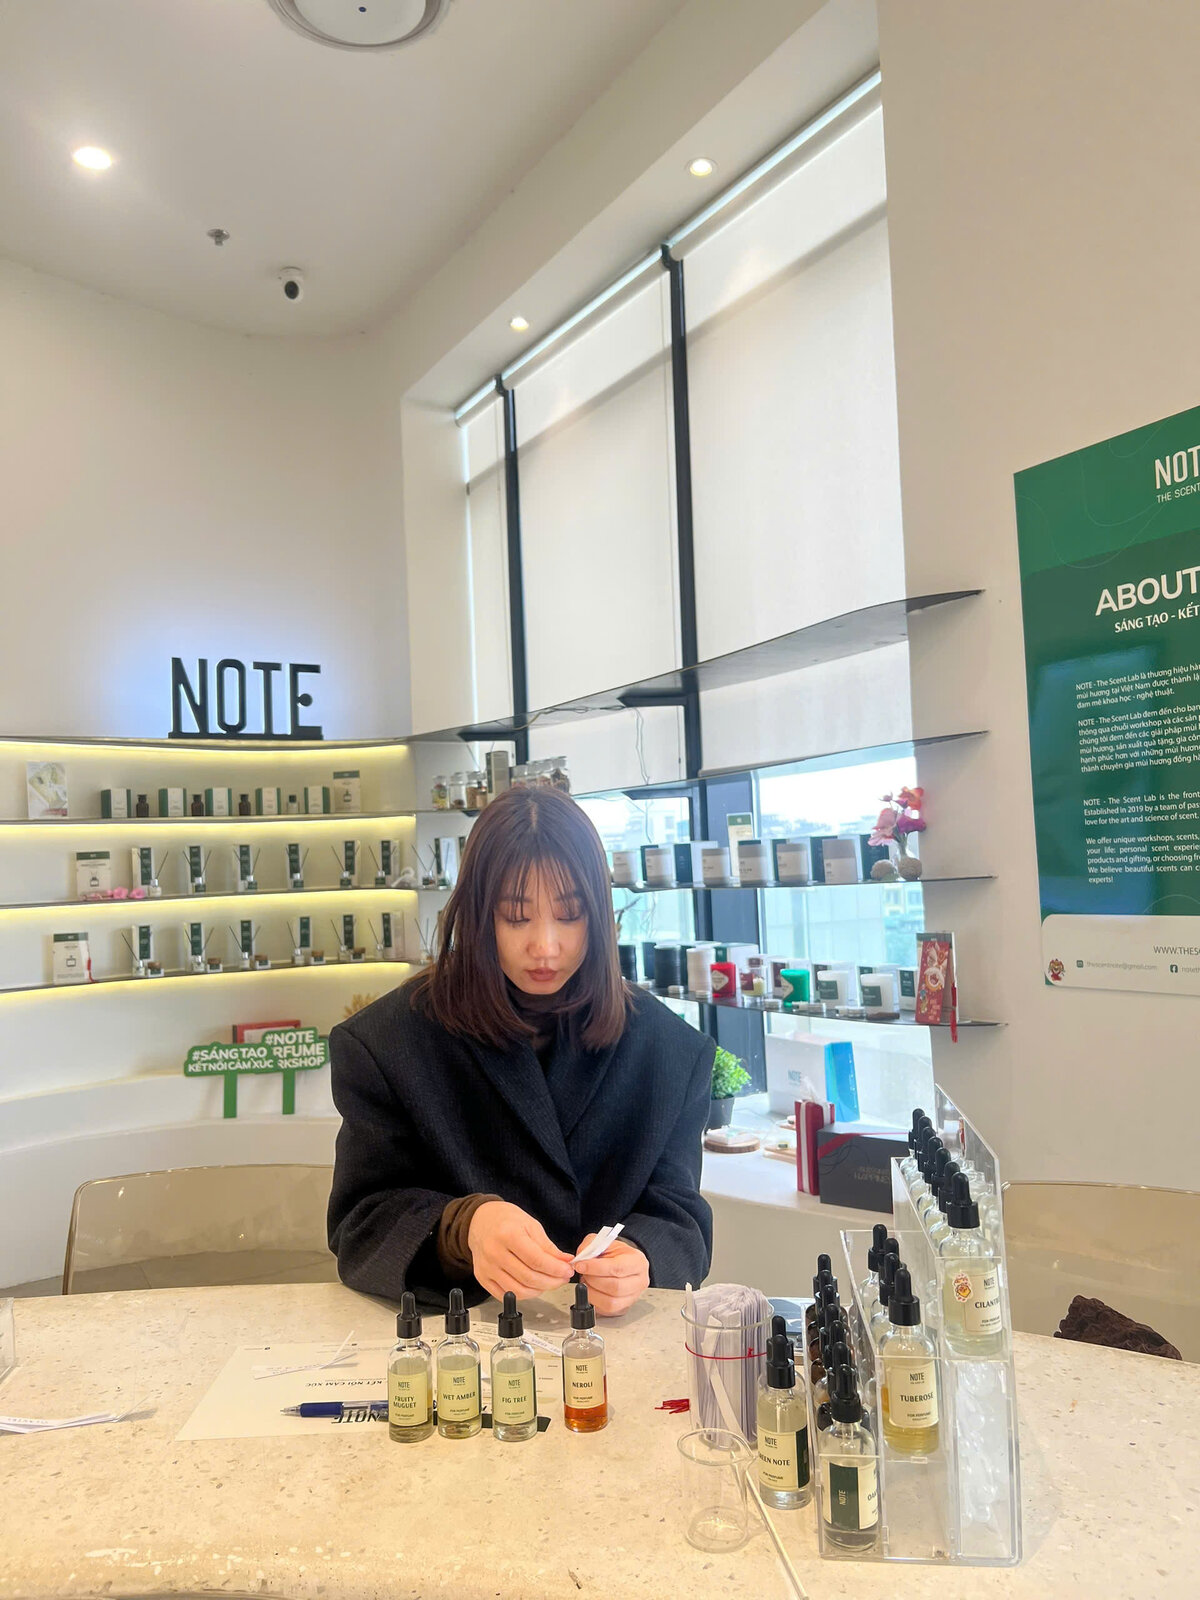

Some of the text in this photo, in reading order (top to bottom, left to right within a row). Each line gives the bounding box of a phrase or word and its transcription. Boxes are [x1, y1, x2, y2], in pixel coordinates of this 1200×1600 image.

[1156, 483, 1200, 503] THE SCENT
[1095, 566, 1200, 616] ABOUT
[1114, 618, 1144, 633] SÁNG
[1145, 612, 1169, 628] TẠO
[1178, 602, 1200, 620] KẾT
[1075, 681, 1093, 691] NOTE
[1109, 676, 1127, 685] Scent
[1128, 673, 1140, 682] Lab
[1140, 672, 1146, 680] là
[1173, 665, 1188, 674] hiệu
[1076, 691, 1088, 700] mùi
[1112, 686, 1120, 695] tại
[1120, 684, 1133, 693] Việt
[1134, 682, 1151, 690] Nam
[1152, 680, 1169, 688] được
[1170, 674, 1192, 684] thành
[171, 657, 322, 737] NOTE
[1076, 700, 1091, 709] đam
[1092, 698, 1102, 706] mê
[1102, 696, 1118, 705] khoa
[1120, 694, 1132, 703] học
[1136, 691, 1154, 701] nghệ
[1078, 718, 1095, 727] NOTE
[1112, 714, 1129, 722] Scent
[1130, 712, 1142, 720] Lab
[1142, 709, 1158, 718] đem
[1158, 706, 1172, 716] đến
[1172, 706, 1186, 714] cho
[1186, 704, 1200, 713] bạn
[1098, 726, 1110, 735] qua
[1130, 718, 1161, 730] workshop
[1162, 717, 1172, 725] và
[1108, 732, 1124, 742] đem
[1124, 730, 1138, 740] đến
[1138, 729, 1150, 738] các
[1164, 725, 1182, 736] pháp
[1183, 723, 1197, 732] mùi
[1143, 739, 1157, 748] quà
[1176, 735, 1187, 744] gia
[1164, 745, 1178, 754] mùi
[1081, 764, 1100, 773] thành
[1124, 760, 1134, 770] gia
[1135, 758, 1148, 766] mùi
[1084, 798, 1100, 806] NOTE
[1108, 797, 1120, 805] The
[1122, 796, 1141, 804] Scent
[1144, 794, 1156, 802] Lab
[1168, 792, 1180, 800] the
[1084, 806, 1119, 816] Established
[1120, 806, 1127, 814] in
[1128, 804, 1144, 813] 2019
[1144, 804, 1153, 813] by
[1160, 803, 1178, 811] team
[1178, 802, 1186, 810] of
[1084, 812, 1200, 826] love for the art and science of scent.
[1097, 836, 1112, 844] offer
[1113, 836, 1136, 846] unique
[1136, 834, 1174, 843] workshops,
[1176, 833, 1200, 841] scents,
[1086, 848, 1101, 856] your
[1104, 846, 1116, 854] life:
[1119, 845, 1148, 855] personal
[1151, 844, 1170, 852] scent
[1088, 856, 1115, 865] products
[1115, 855, 1128, 864] and
[1128, 854, 1152, 864] gifting,
[1160, 853, 1192, 862] choosing
[1088, 866, 1098, 874] We
[1100, 865, 1122, 874] believe
[1124, 864, 1154, 873] beautiful
[1156, 864, 1178, 872] scents
[1180, 864, 1192, 872] can
[1088, 876, 1114, 884] experts!
[265, 1030, 314, 1046] #NOTE
[192, 1046, 239, 1061] #SÁNG
[272, 1042, 325, 1058] RFUME
[278, 1056, 325, 1069] RKSHOP
[576, 1364, 588, 1372] NOTE
[453, 1376, 466, 1384] NOTE
[508, 1379, 520, 1387] NOTE
[910, 1372, 924, 1381] NOTE
[456, 1392, 476, 1400] AMBER
[900, 1392, 934, 1402] TUBEROSE
[393, 1401, 416, 1409] MUGUET
[764, 1436, 777, 1446] NOTE
[758, 1453, 790, 1466] REEN NOTE
[838, 1490, 846, 1506] NOTE
